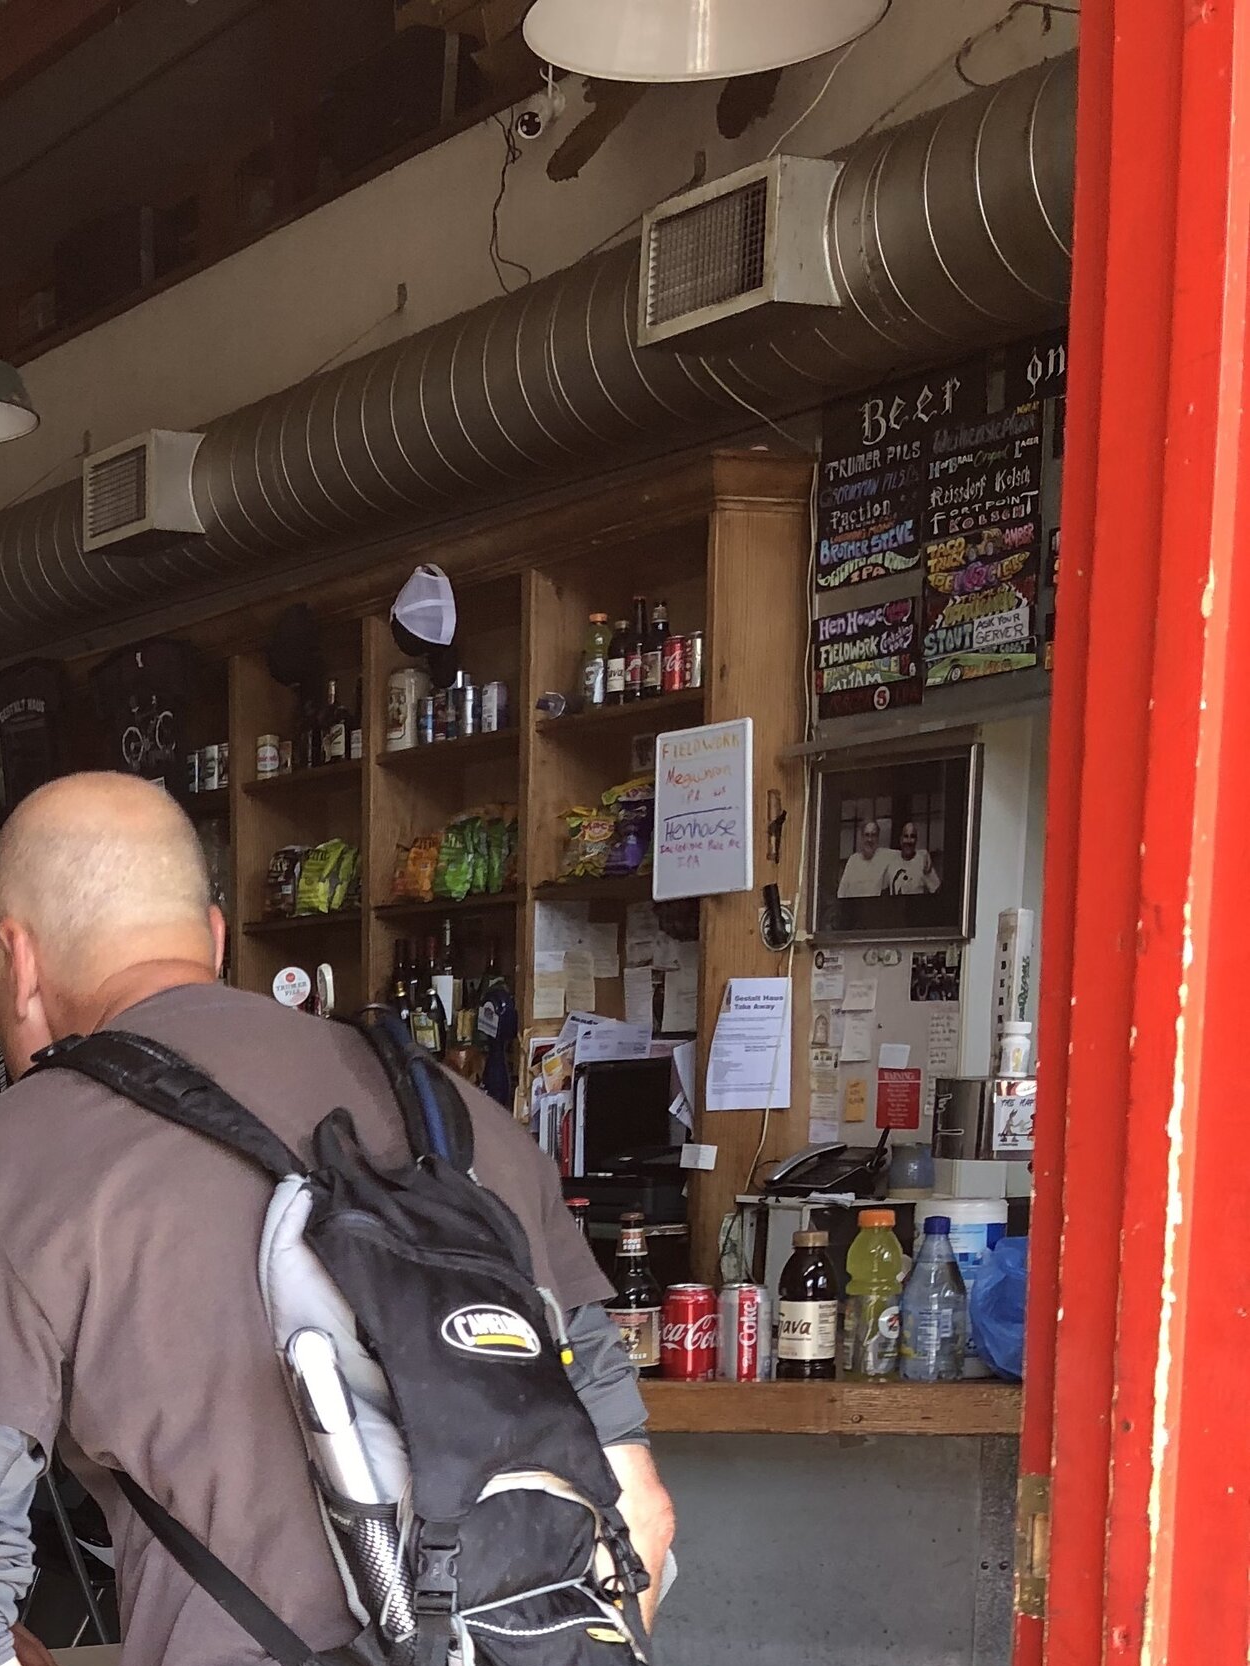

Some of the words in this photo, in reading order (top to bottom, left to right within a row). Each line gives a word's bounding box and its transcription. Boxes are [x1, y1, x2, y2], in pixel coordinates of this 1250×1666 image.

[858, 376, 961, 446] Beer
[1026, 345, 1066, 399] on
[824, 449, 882, 481] TRUMER
[886, 440, 921, 464] PILS
[928, 473, 987, 510] Reissdorf
[820, 540, 870, 566] BROTHER
[870, 519, 915, 553] STEVE
[927, 537, 966, 557] TACO
[1003, 523, 1035, 548] AMBER
[850, 565, 887, 584] IPA
[819, 617, 846, 641] Hen
[975, 618, 994, 631] ASK
[975, 624, 1024, 645] SERVER
[819, 635, 879, 669] FIELDWORK
[924, 623, 973, 657] STOUT
[662, 734, 740, 760] FIELDWORK
[665, 819, 737, 842] Henhouse
[753, 1003, 776, 1011] Away
[739, 1297, 758, 1345] Coke
